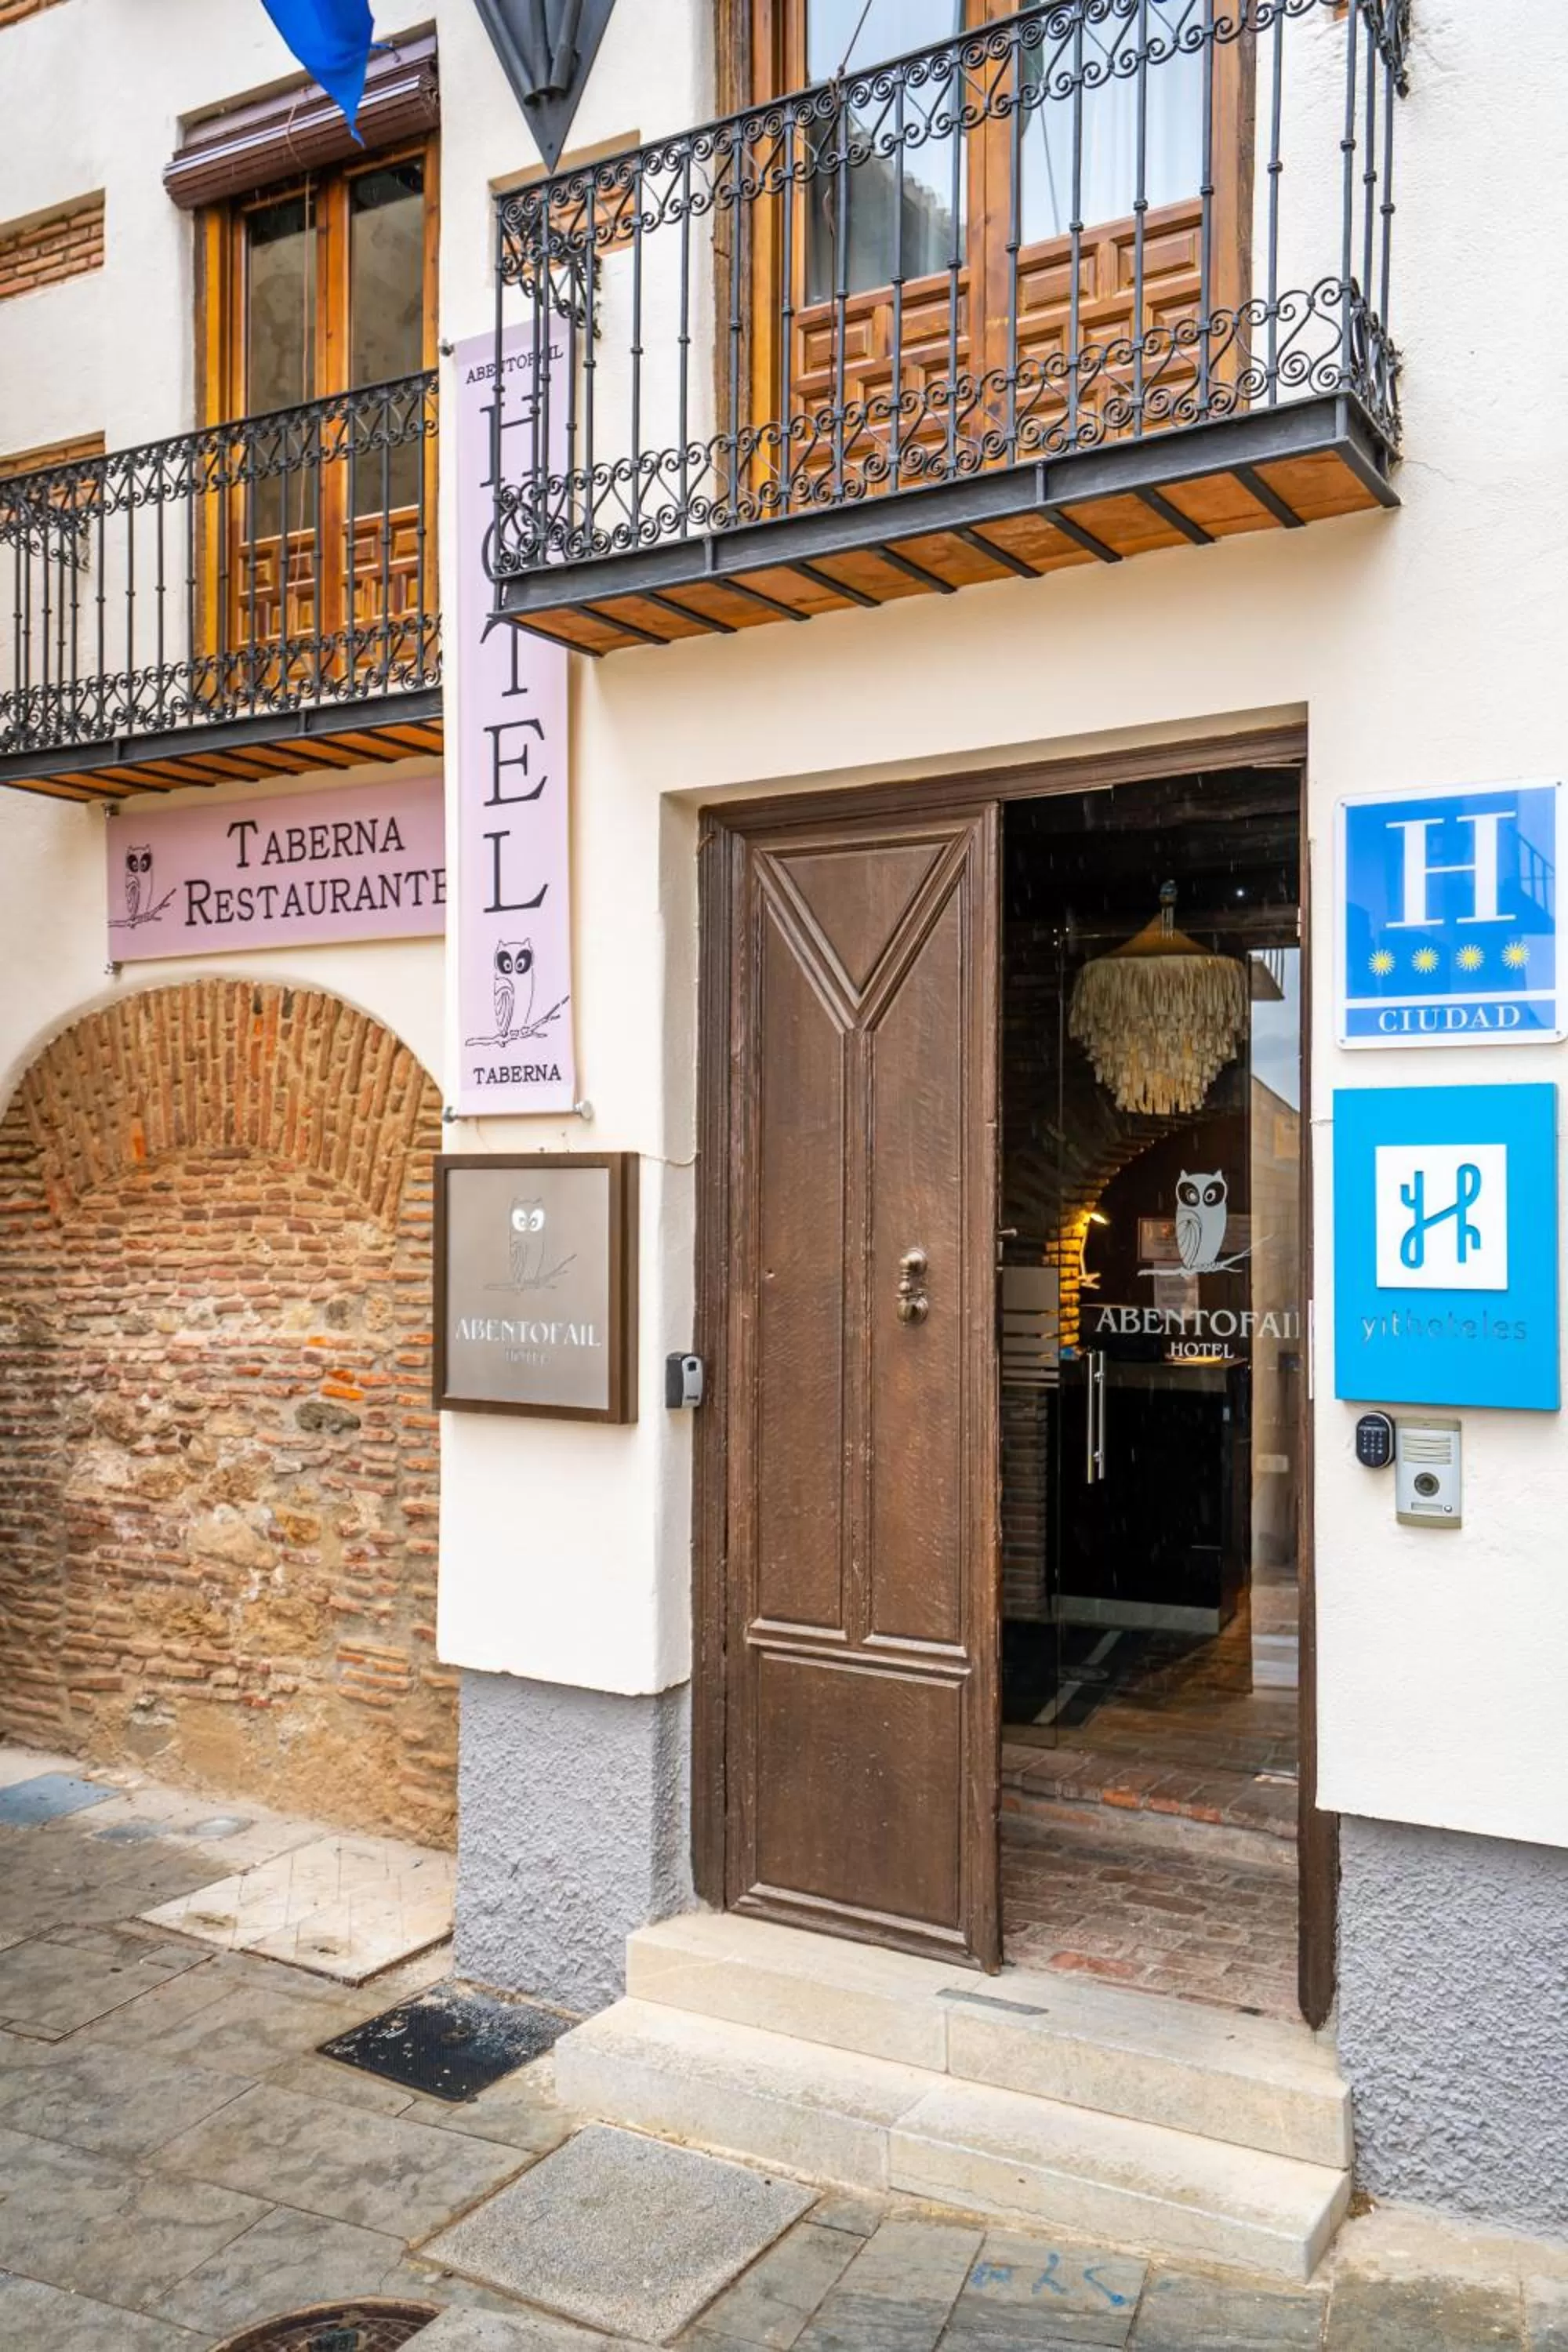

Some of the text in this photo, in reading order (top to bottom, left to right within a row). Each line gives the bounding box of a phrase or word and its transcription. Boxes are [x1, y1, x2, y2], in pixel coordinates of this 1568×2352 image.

[466, 345, 564, 384] ABETOFIL
[227, 815, 406, 869] TABERNA
[1385, 811, 1517, 929] H
[184, 868, 446, 927] RESTAURANTE
[1377, 1004, 1521, 1033] CIUDAD
[473, 1064, 562, 1086] TABERNA
[455, 1318, 603, 1348] ABENTOFAIL
[1170, 1341, 1236, 1359] HOTEL
